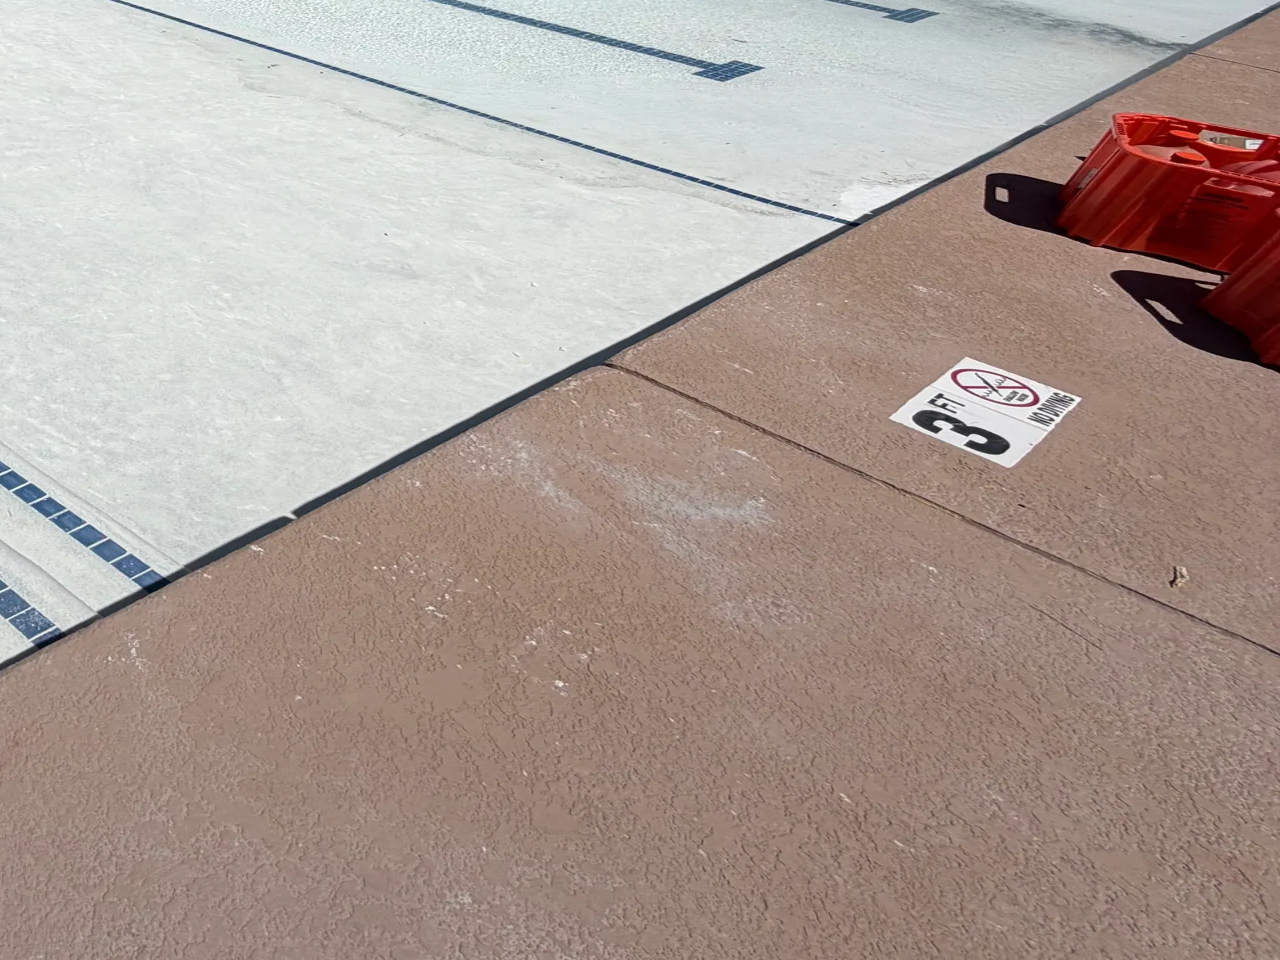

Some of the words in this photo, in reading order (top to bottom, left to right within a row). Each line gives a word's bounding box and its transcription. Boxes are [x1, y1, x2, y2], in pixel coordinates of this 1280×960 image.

[927, 393, 966, 414] FT
[1036, 391, 1076, 418] DIVING
[1026, 411, 1056, 427] NO
[912, 410, 1010, 455] 3
